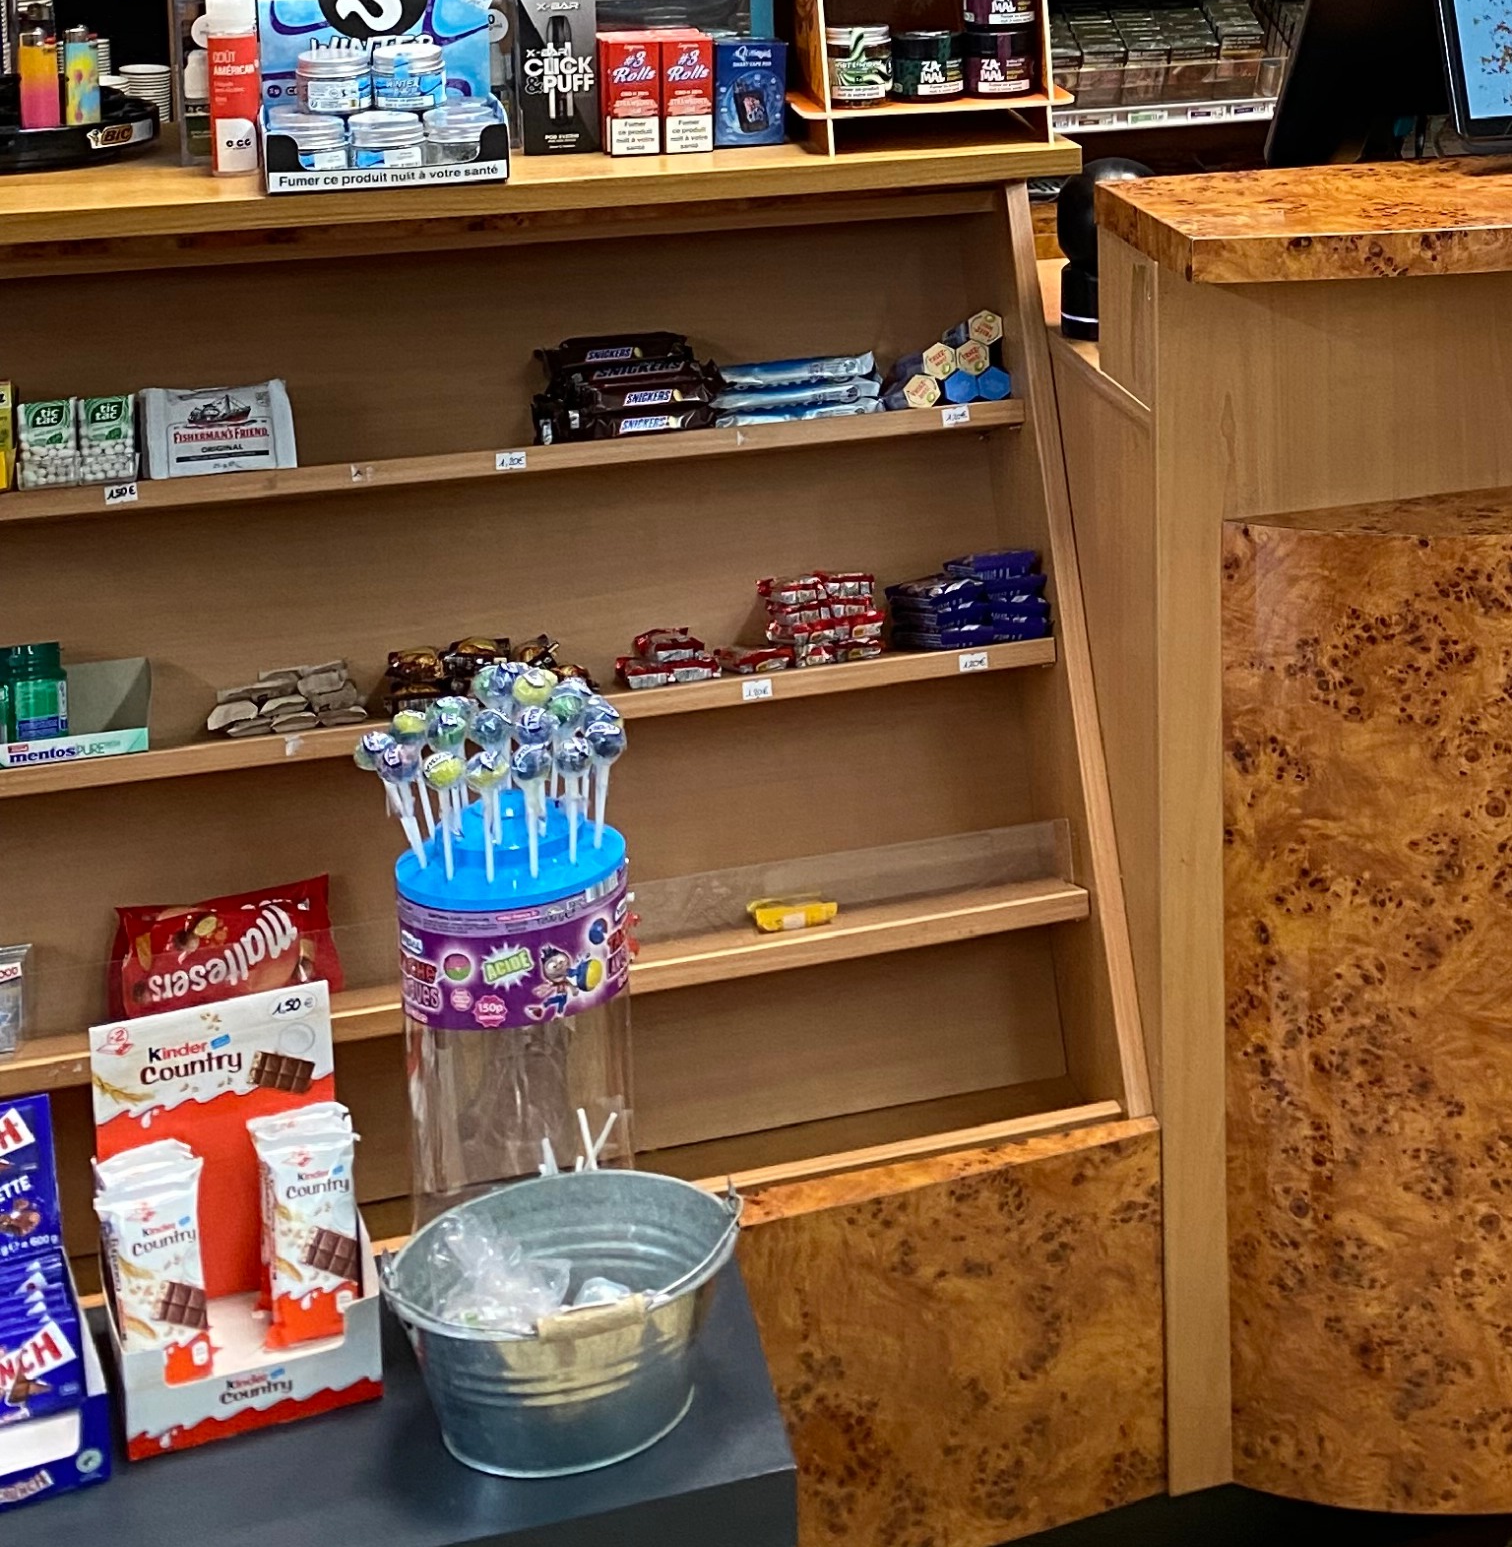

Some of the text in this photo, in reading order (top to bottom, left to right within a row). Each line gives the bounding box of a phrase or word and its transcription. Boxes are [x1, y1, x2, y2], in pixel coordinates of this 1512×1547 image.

[537, 2, 580, 10] X-BAR
[992, 2, 1016, 13] MAL
[525, 57, 592, 77] CLICK
[667, 65, 709, 82] Rolls
[613, 67, 655, 84] Rolls
[921, 71, 945, 83] MAL
[980, 70, 1005, 82] MAL
[544, 74, 594, 94] PUFF
[102, 125, 132, 143] BIC
[279, 165, 500, 188] Fumer ce produit nuit à votre santé
[588, 347, 632, 361] SNICKERS
[597, 361, 683, 378] SNICKERS
[627, 390, 671, 404] SNICKERS
[41, 407, 60, 418] tic
[95, 411, 117, 422] tac
[100, 403, 119, 414] tic
[36, 414, 58, 425] tac
[623, 418, 667, 431] SNICKERS
[174, 429, 233, 444] FISHERMAN'S
[201, 444, 244, 454] ORIGINAL
[9, 745, 76, 763] mentos
[148, 902, 297, 1002] maltesers
[488, 951, 532, 981] ACIDE
[140, 1052, 242, 1085] Country
[286, 1177, 350, 1200] Country
[132, 1228, 197, 1257] Country
